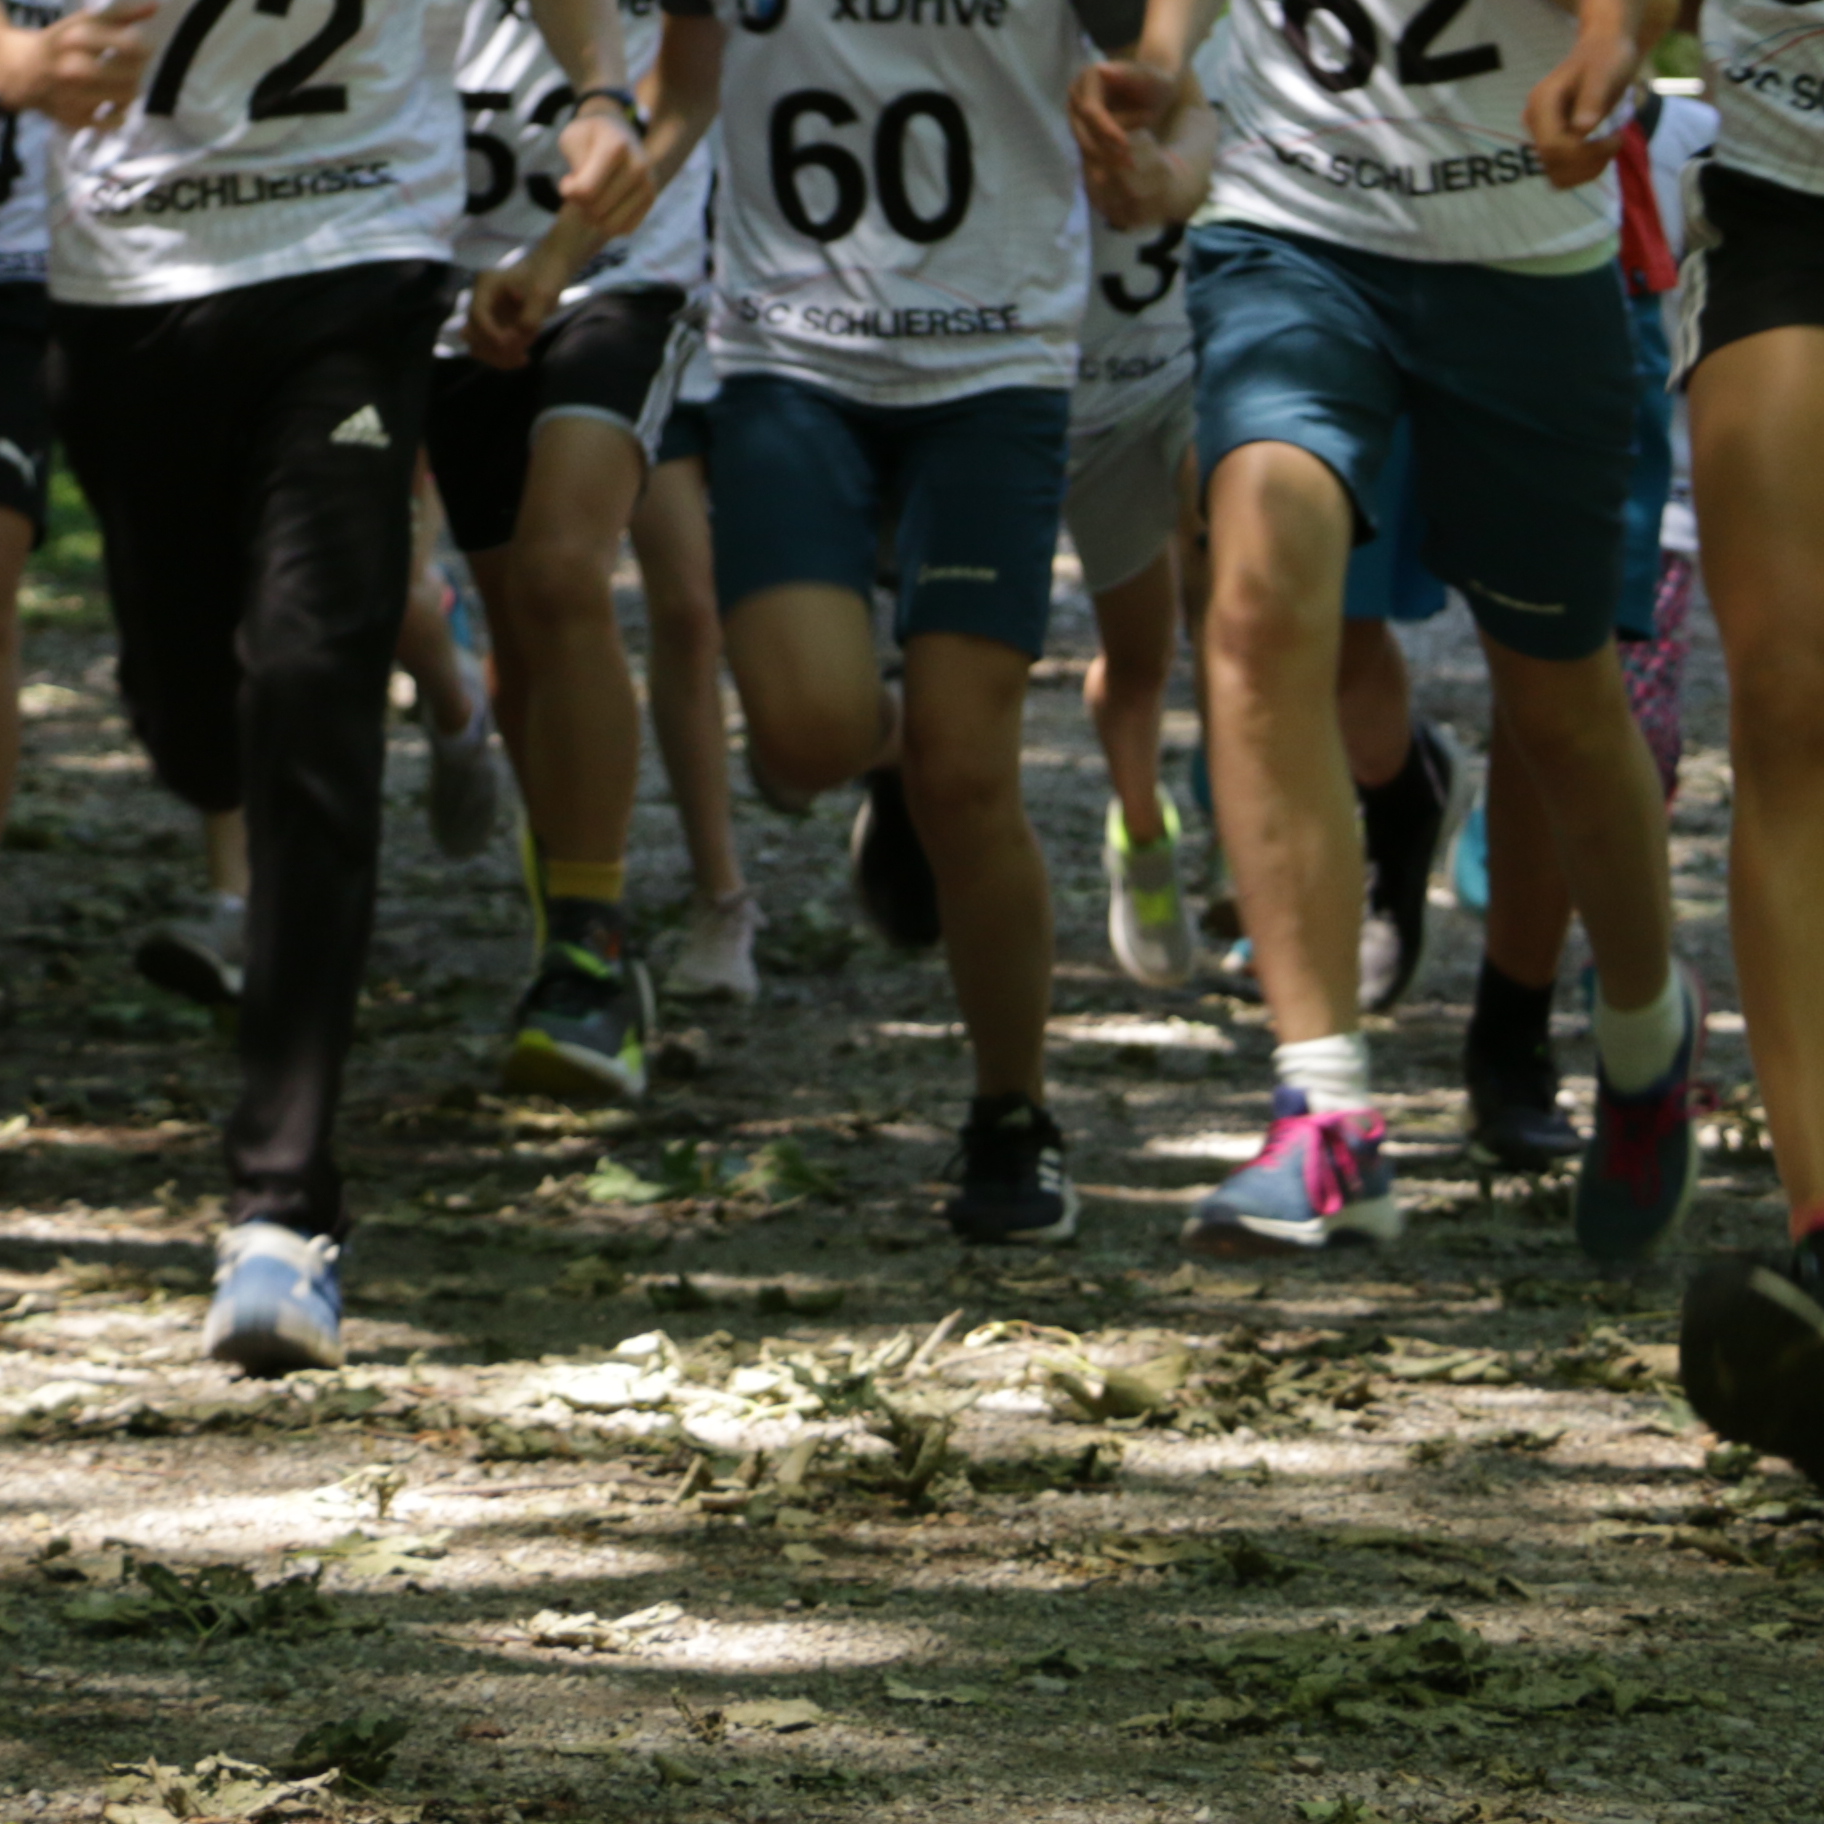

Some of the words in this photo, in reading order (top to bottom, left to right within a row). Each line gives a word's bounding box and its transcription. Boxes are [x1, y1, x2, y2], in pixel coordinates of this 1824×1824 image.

[143, 162, 400, 215] SCHLIERSEE
[768, 89, 973, 244] 60
[738, 294, 792, 326] SC
[802, 302, 1023, 339] SCHLIERSEE
